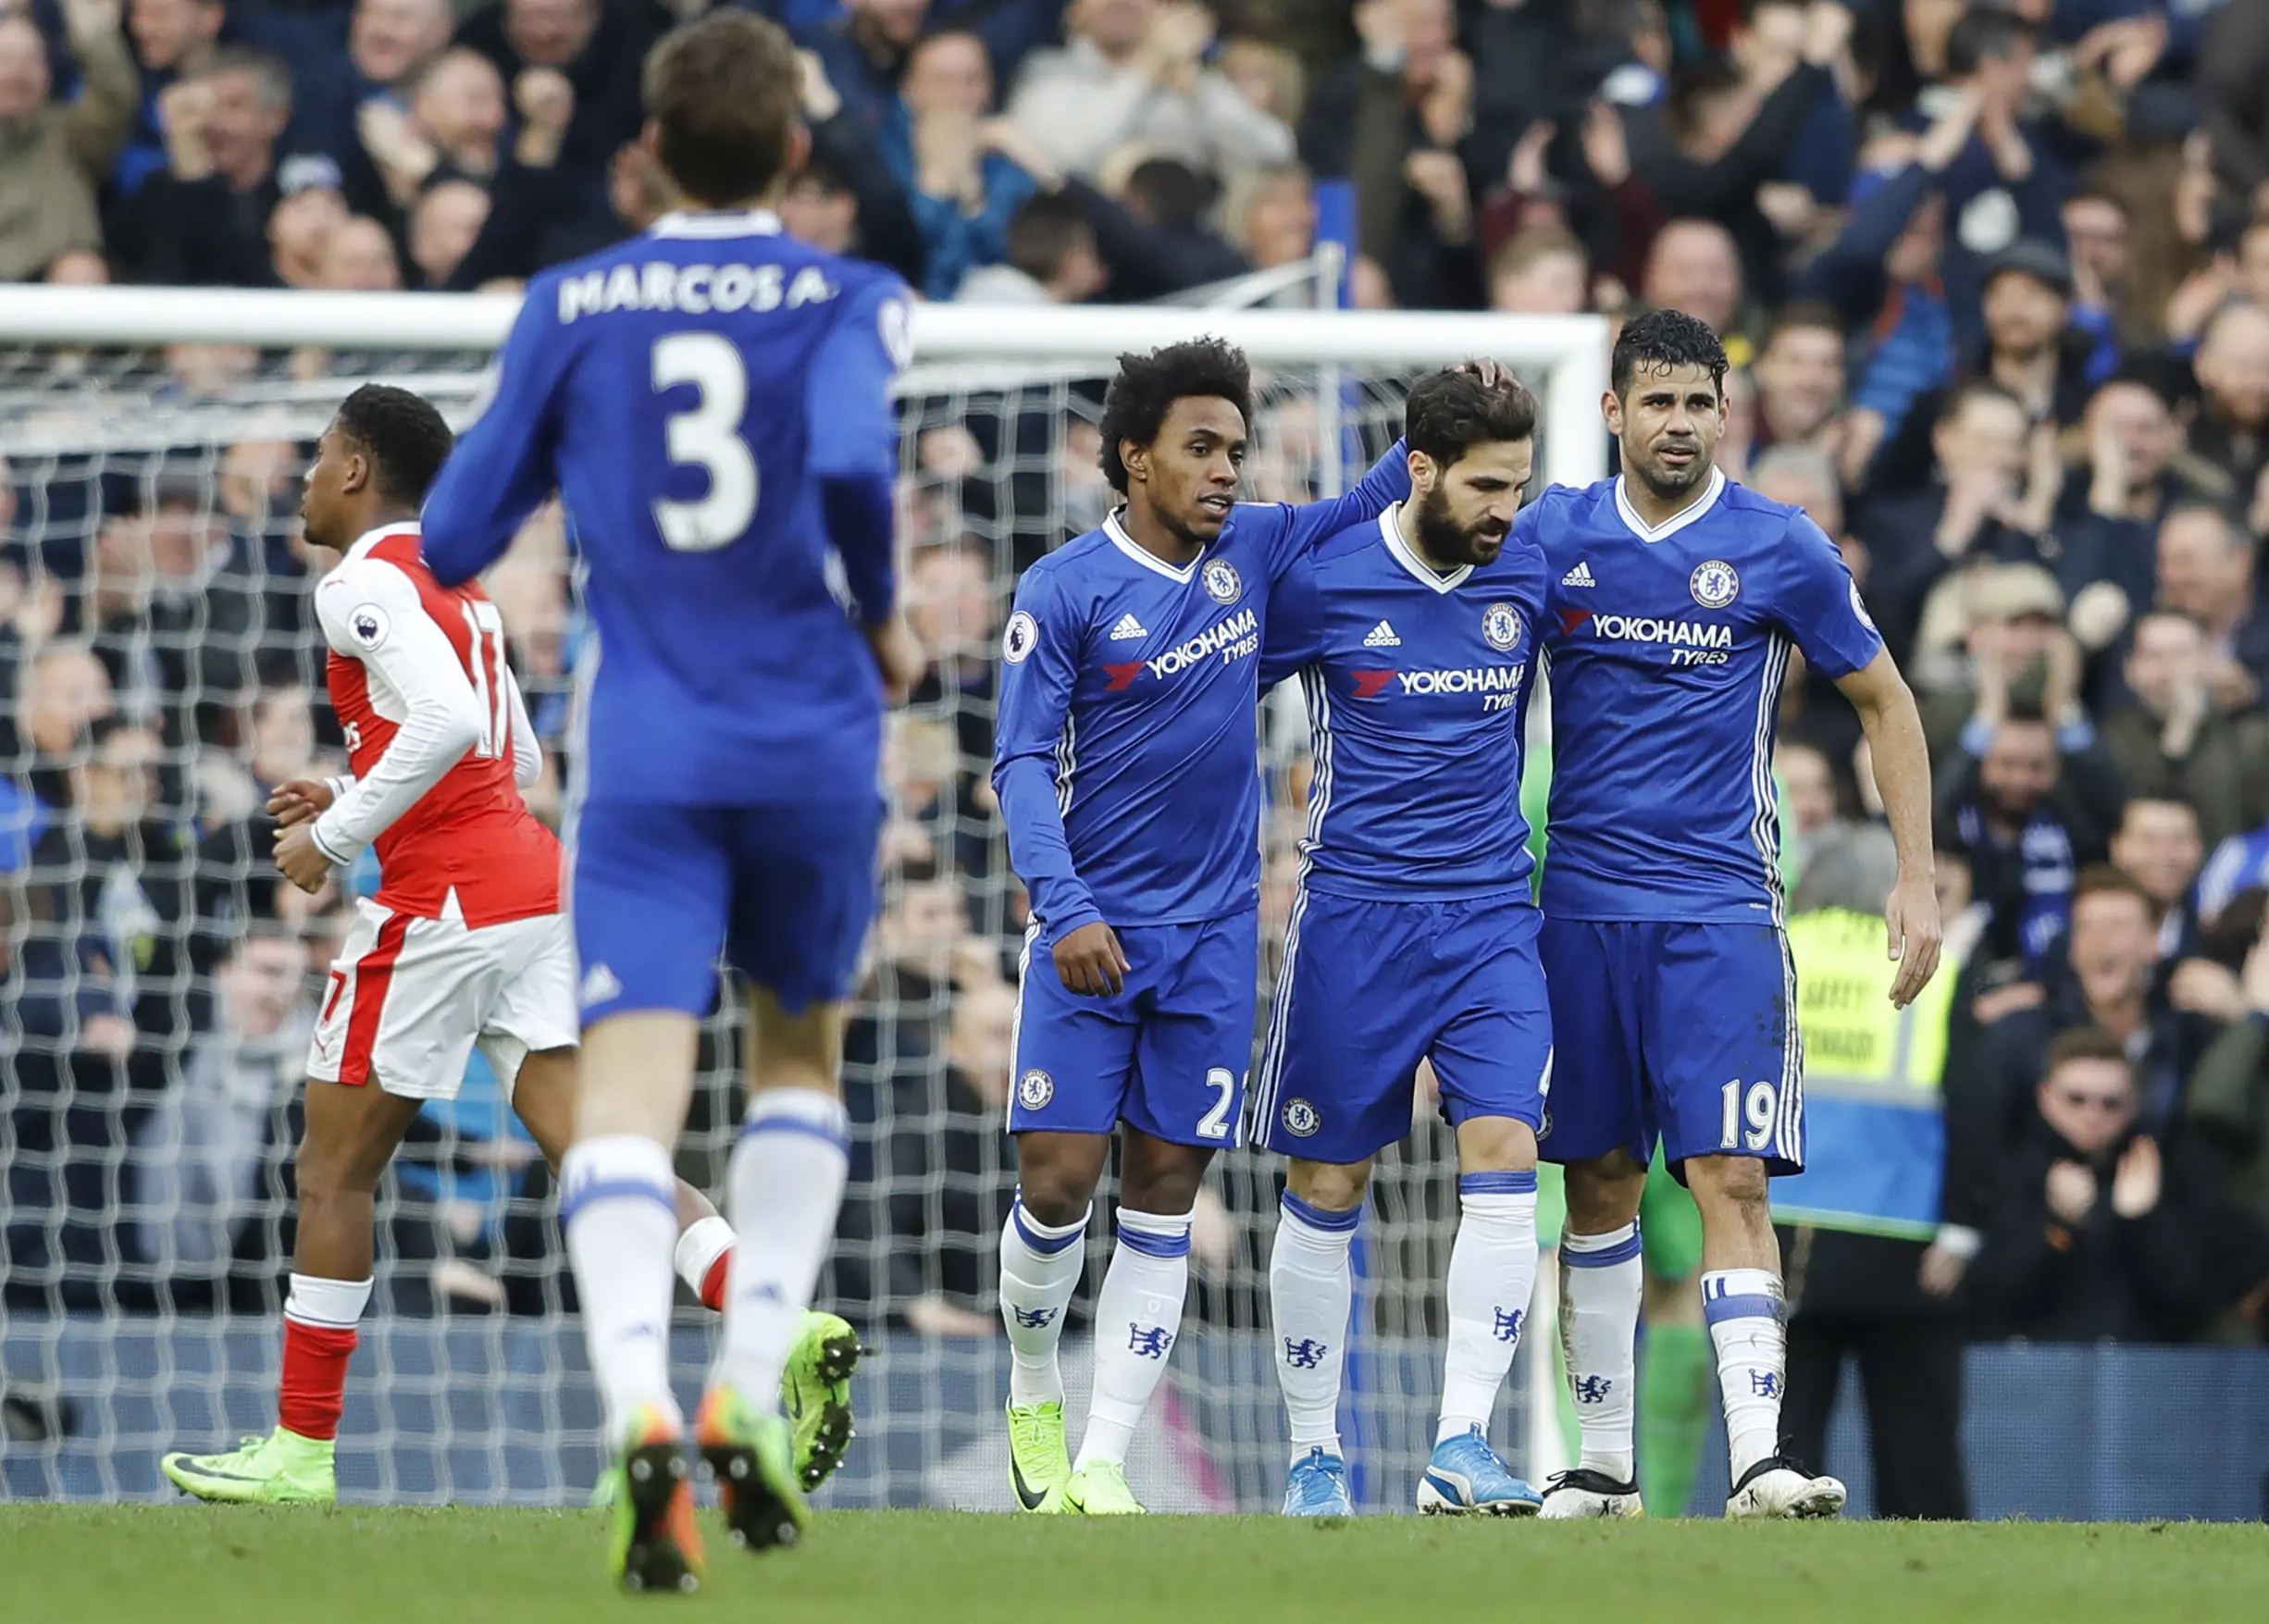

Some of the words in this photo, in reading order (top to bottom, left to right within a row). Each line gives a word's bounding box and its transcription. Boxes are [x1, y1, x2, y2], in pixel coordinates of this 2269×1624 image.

[557, 260, 787, 325] MARCOS
[650, 329, 762, 552] 3
[1561, 576, 1597, 589] adidas
[1110, 627, 1148, 641] adidas
[1146, 607, 1258, 681] YOKOHAMA
[1221, 631, 1259, 665] TYRES
[1363, 636, 1403, 648] adidas
[1591, 613, 1733, 650] YOKOHAMA
[1669, 648, 1730, 666] TYRES
[461, 599, 508, 761] 17
[1482, 690, 1519, 713] TYRE
[1720, 1078, 1778, 1150] 19
